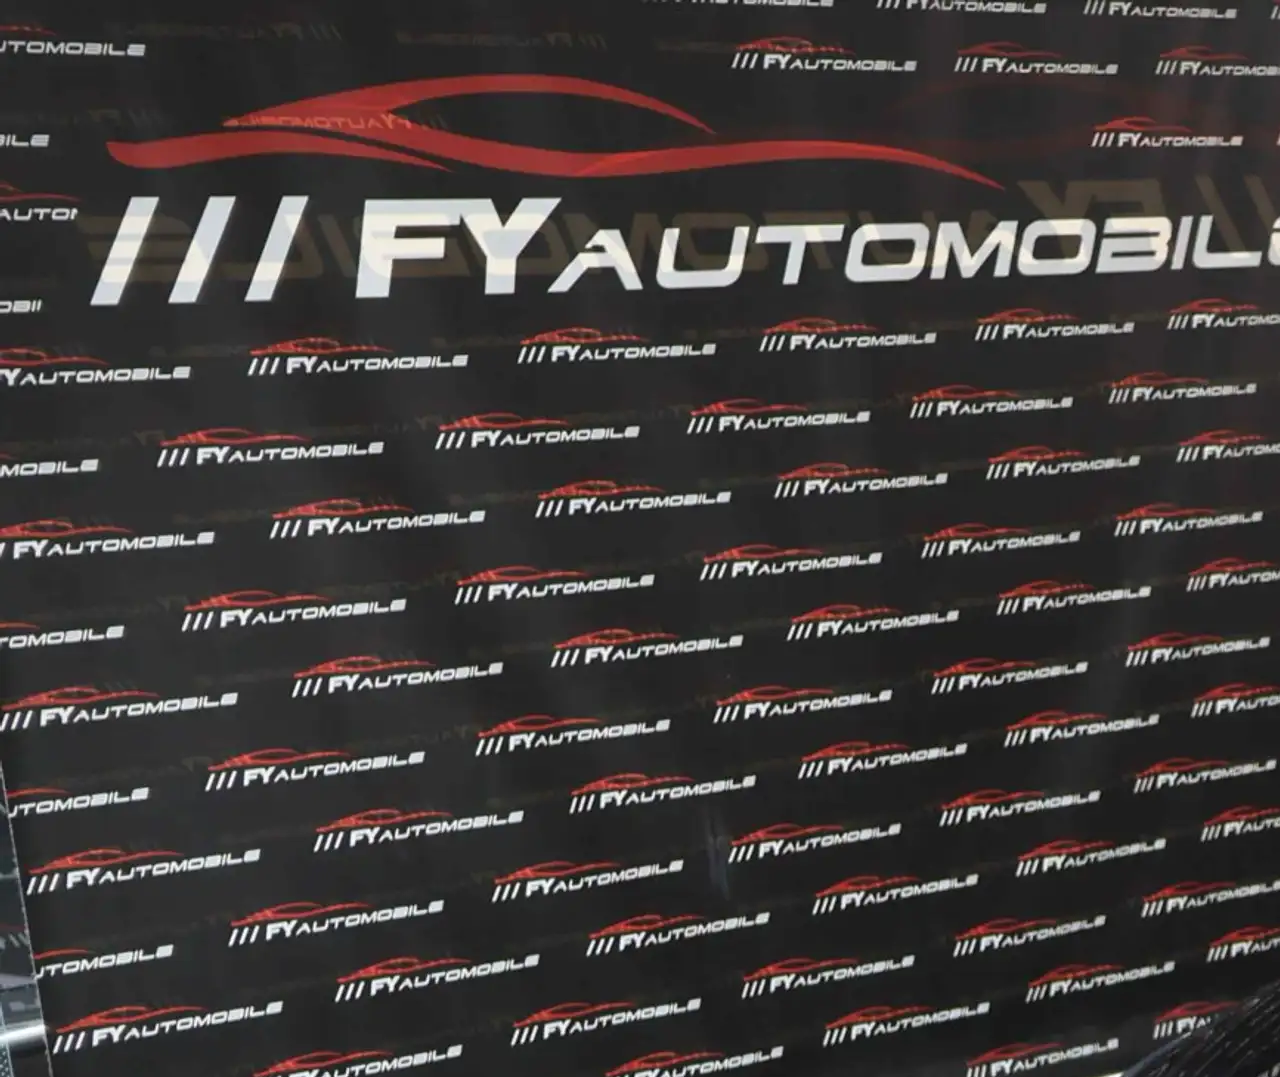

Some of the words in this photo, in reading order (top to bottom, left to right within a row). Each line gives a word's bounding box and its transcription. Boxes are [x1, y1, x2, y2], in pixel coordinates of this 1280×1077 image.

[1108, 1, 1238, 19] FYAUTOMOBILE
[763, 53, 917, 72] FYAUTOMOBILE
[981, 57, 1119, 75] FYAUTOMOBILE
[1117, 132, 1244, 148] FYAUTOMOBILE
[789, 332, 937, 351] FYAUTOMOBILE
[1002, 322, 1135, 340] FYAUTOMOBILE
[286, 354, 469, 375] FYAUTOMOBILE
[550, 343, 717, 363] FYAUTOMOBILE
[936, 396, 1074, 417] FYAUTOMOBILE
[1131, 383, 1257, 402] FYAUTOMOBILE
[718, 410, 871, 433] FYAUTOMOBILE
[470, 425, 641, 449] FYAUTOMOBILE
[196, 441, 385, 466] FYAUTOMOBILE
[1013, 455, 1141, 478] FYAUTOMOBILE
[803, 472, 948, 496] FYAUTOMOBILE
[568, 491, 732, 516] FYAUTOMOBILE
[307, 509, 486, 537] FYAUTOMOBILE
[1139, 510, 1264, 535] FYAUTOMOBILE
[12, 531, 216, 560] FYAUTOMOBILE
[947, 531, 1081, 556] FYAUTOMOBILE
[731, 551, 883, 578] FYAUTOMOBILE
[487, 574, 655, 602] FYAUTOMOBILE
[1022, 585, 1152, 612] FYAUTOMOBILE
[219, 598, 407, 629] FYAUTOMOBILE
[816, 609, 960, 638] FYAUTOMOBILE
[584, 634, 744, 665] FYAUTOMOBILE
[1150, 636, 1271, 664] FYAUTOMOBILE
[327, 661, 504, 694] FYAUTOMOBILE
[958, 661, 1089, 691] FYAUTOMOBILE
[39, 692, 239, 727] FYAUTOMOBILE
[743, 689, 893, 720] FYAUTOMOBILE
[508, 718, 671, 752] FYAUTOMOBILE
[1029, 713, 1160, 744] FYAUTOMOBILE
[242, 750, 426, 787] FYAUTOMOBILE
[827, 742, 968, 776] FYAUTOMOBILE
[1156, 759, 1277, 789] FYAUTOMOBILE
[599, 774, 757, 809] FYAUTOMOBILE
[966, 790, 1101, 823] FYAUTOMOBILE
[349, 810, 525, 848] FYAUTOMOBILE
[758, 823, 902, 859] FYAUTOMOBILE
[65, 848, 261, 890] FYAUTOMOBILE
[1041, 838, 1167, 873] FYAUTOMOBILE
[525, 859, 684, 898] FYAUTOMOBILE
[840, 873, 979, 910] FYAUTOMOBILE
[265, 899, 445, 942] FYAUTOMOBILE
[618, 911, 771, 952] FYAUTOMOBILE
[979, 915, 1106, 952] FYAUTOMOBILE
[370, 953, 540, 997] FYAUTOMOBILE
[769, 954, 915, 993] FYAUTOMOBILE
[1049, 961, 1176, 997] FYAUTOMOBILE
[91, 1000, 284, 1047] FYAUTOMOBILE
[542, 997, 702, 1040] FYAUTOMOBILE
[850, 1001, 990, 1041] FYAUTOMOBILE
[990, 1037, 1119, 1077] FYAUTOMOBILE
